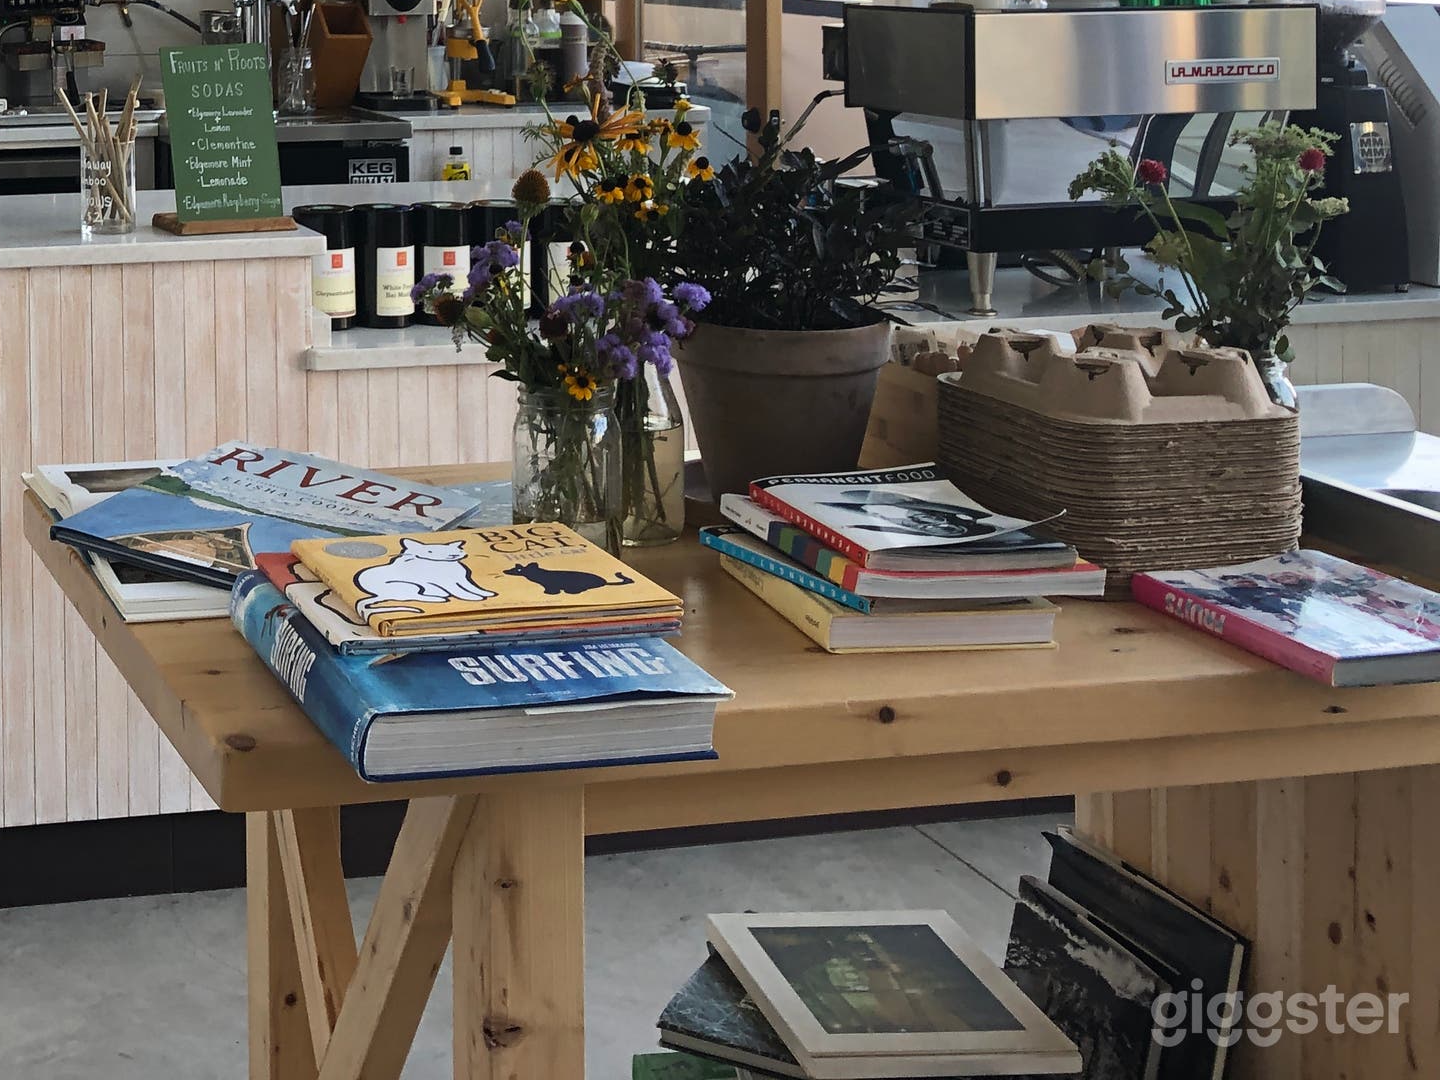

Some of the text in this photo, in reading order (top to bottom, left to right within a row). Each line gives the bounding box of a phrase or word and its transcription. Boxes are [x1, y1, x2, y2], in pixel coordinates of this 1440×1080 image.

[1191, 64, 1275, 77] MARZOCCO
[191, 82, 245, 98] SODAS
[231, 155, 253, 168] Mint
[352, 162, 393, 174] KEG
[200, 171, 249, 188] Lemonade
[208, 447, 443, 517] RIVER
[767, 468, 937, 486] PERMANENT FOOD
[221, 475, 289, 499] ELISHA
[298, 496, 375, 520] COOPER
[471, 525, 565, 544] BIG
[489, 535, 588, 554] CAT,
[504, 548, 554, 562] little
[1163, 591, 1226, 635] FRUITS
[270, 619, 317, 705] SURFING
[447, 648, 672, 686] SURFING
